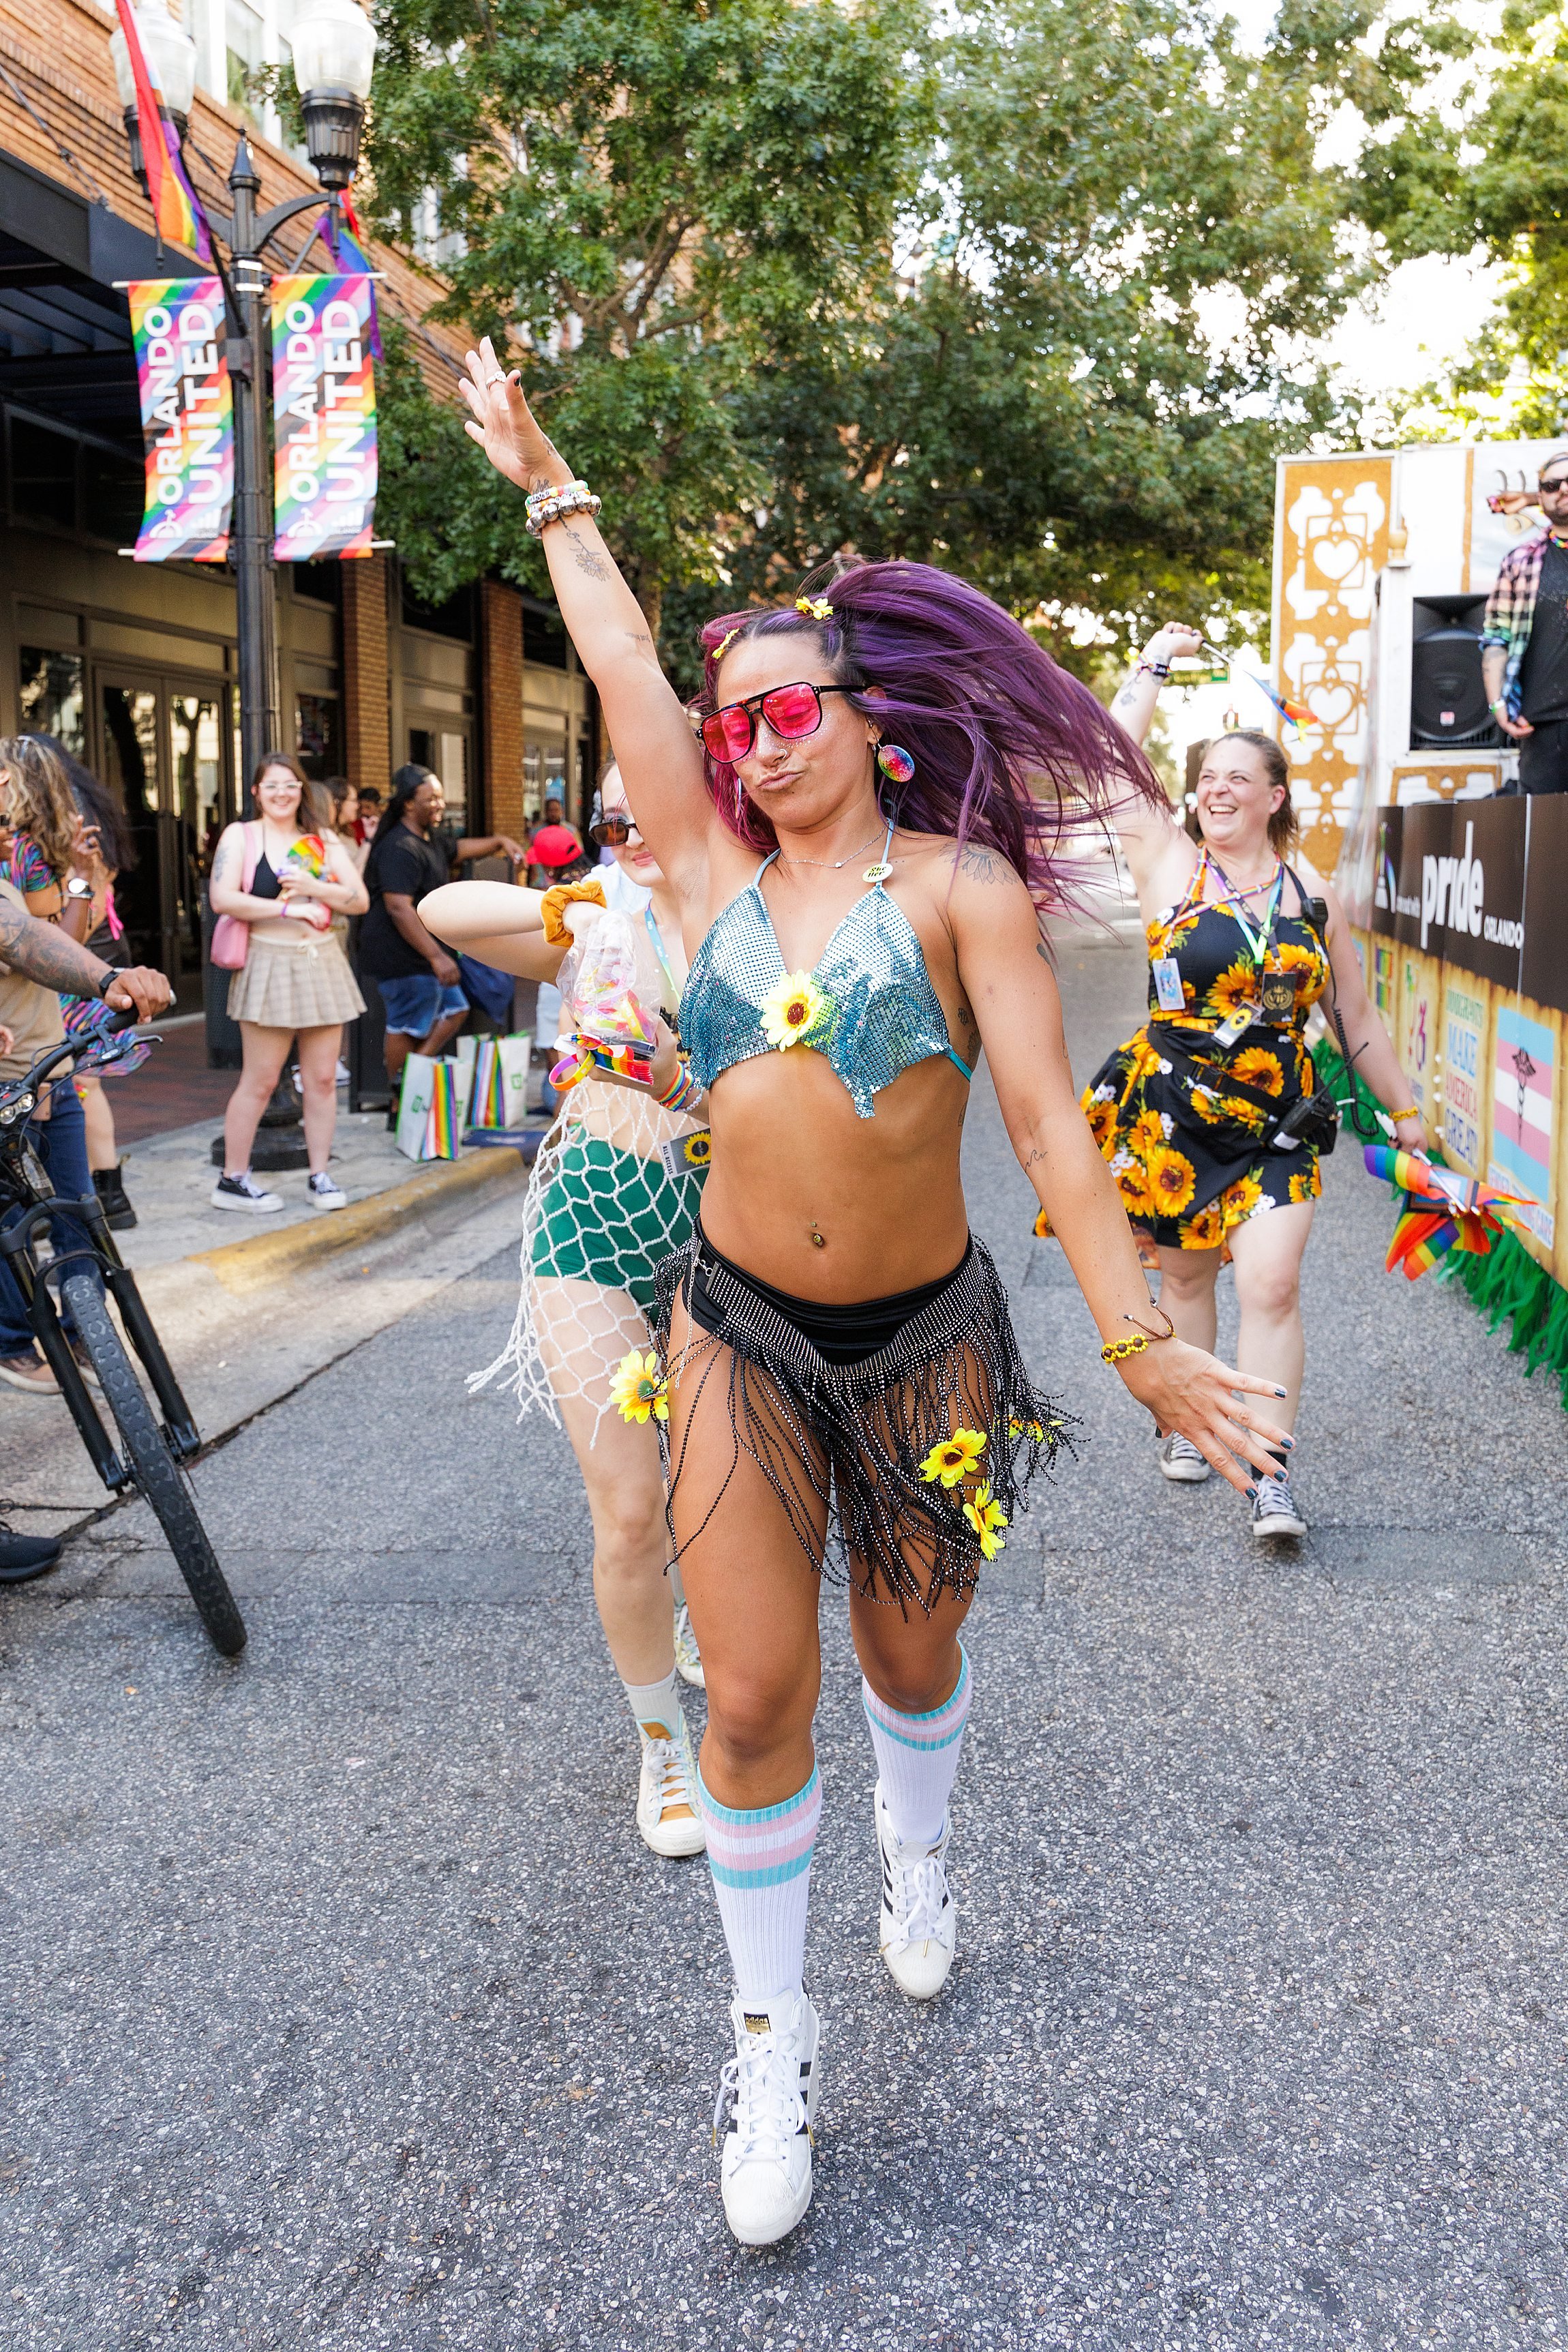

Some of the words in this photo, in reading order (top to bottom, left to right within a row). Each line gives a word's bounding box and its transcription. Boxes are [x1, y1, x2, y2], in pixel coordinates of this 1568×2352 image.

[144, 306, 183, 505] ORLANDO
[179, 304, 223, 505] UNITED
[285, 301, 320, 502] ORLANDO
[321, 300, 366, 502] UNITED
[1421, 820, 1484, 949] pride
[1483, 914, 1524, 949] ORLANDO
[1269, 993, 1287, 1004] VIP
[1447, 1022, 1478, 1079] MAKE
[1445, 1069, 1478, 1122] AMERICA
[665, 1157, 674, 1174] ACCESS
[745, 2016, 768, 2025] adidas
